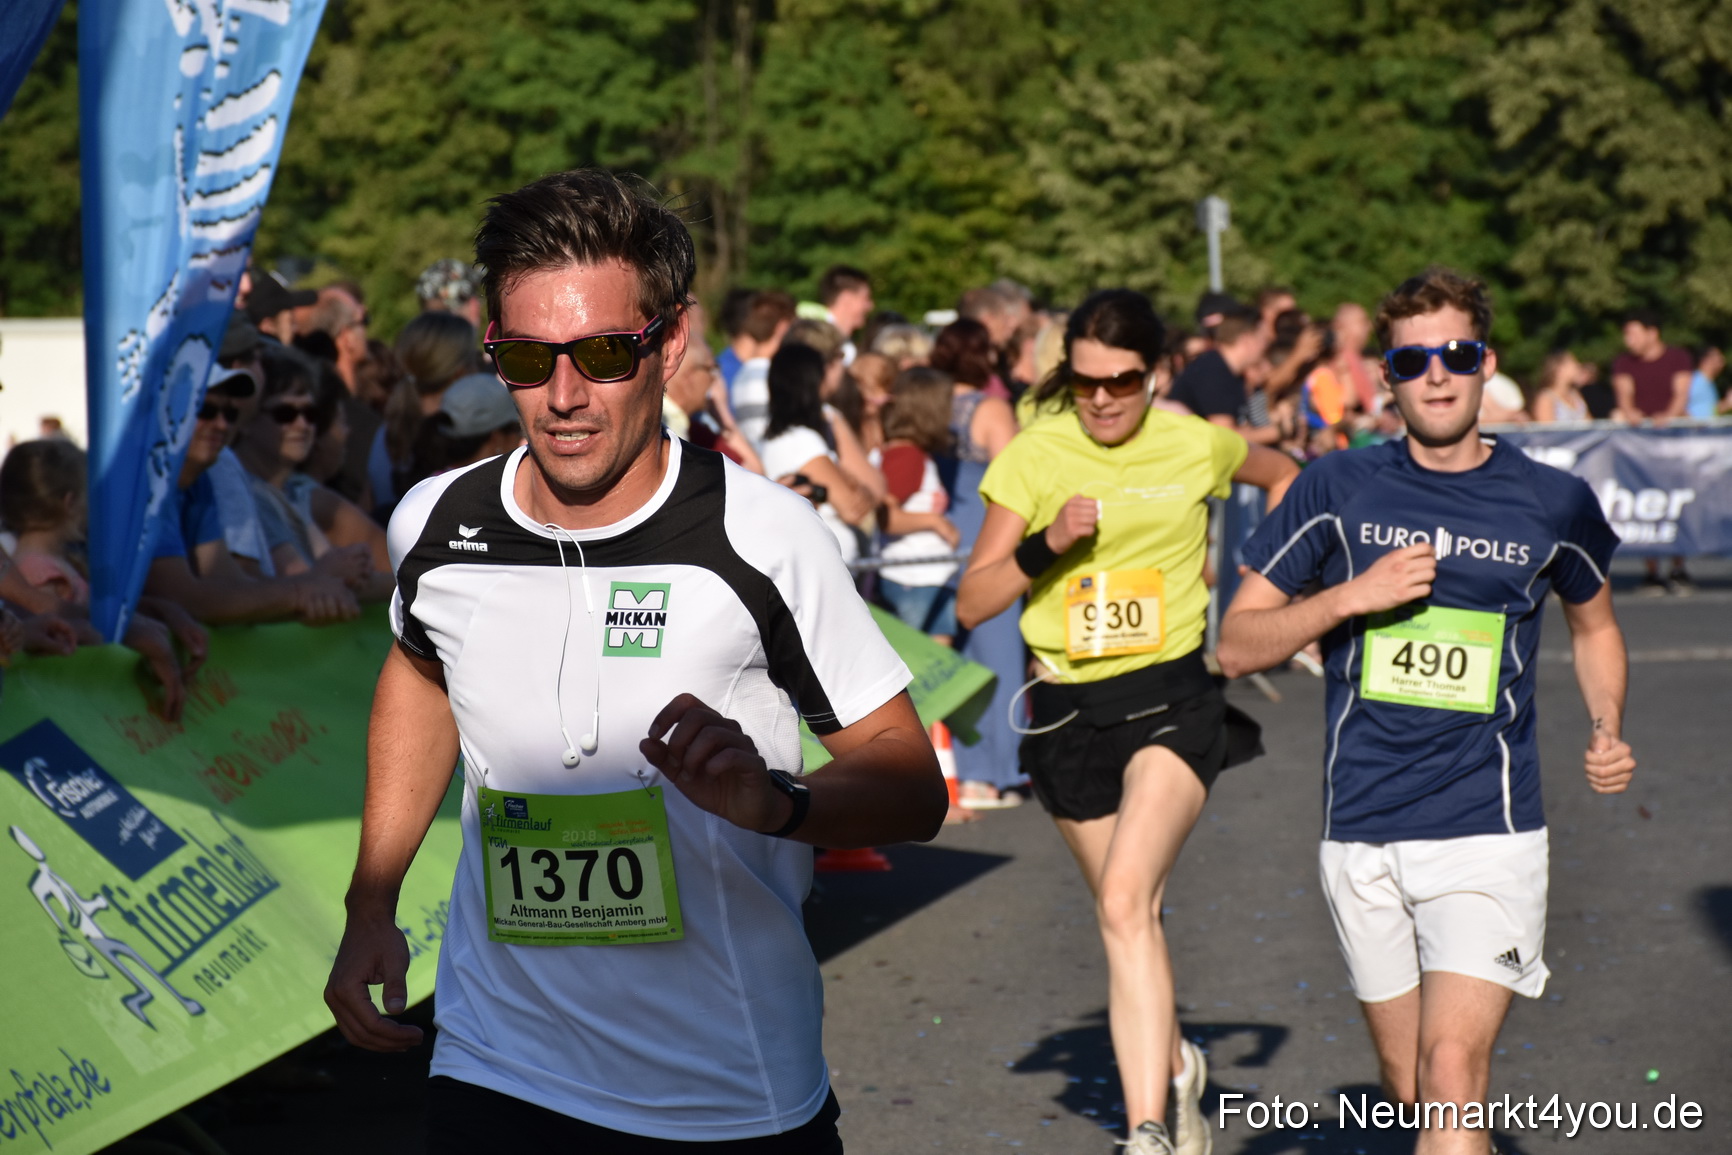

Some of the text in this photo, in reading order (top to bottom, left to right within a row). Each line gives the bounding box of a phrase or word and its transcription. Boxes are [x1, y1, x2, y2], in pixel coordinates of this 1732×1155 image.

[1601, 478, 1695, 521] her
[448, 539, 489, 552] erima
[1360, 522, 1531, 566] EURO POLES
[605, 611, 667, 626] MICKAN
[1084, 601, 1142, 631] 930
[1392, 641, 1468, 680] 490
[1392, 676, 1467, 692] Harrer Thomas
[46, 767, 105, 809] Fischer
[496, 814, 552, 831] firmenlauf
[561, 830, 597, 843] 2018
[101, 811, 279, 967] firmenlauf
[500, 847, 644, 902] 1370
[494, 916, 668, 929] Mickan General-Bau-Gesellschaft Amberg mbH
[510, 903, 644, 920] Altmann Benjamin
[193, 923, 268, 996] neumarkt
[1494, 957, 1523, 975] adidas
[0, 1047, 111, 1153] erpfalz.de
